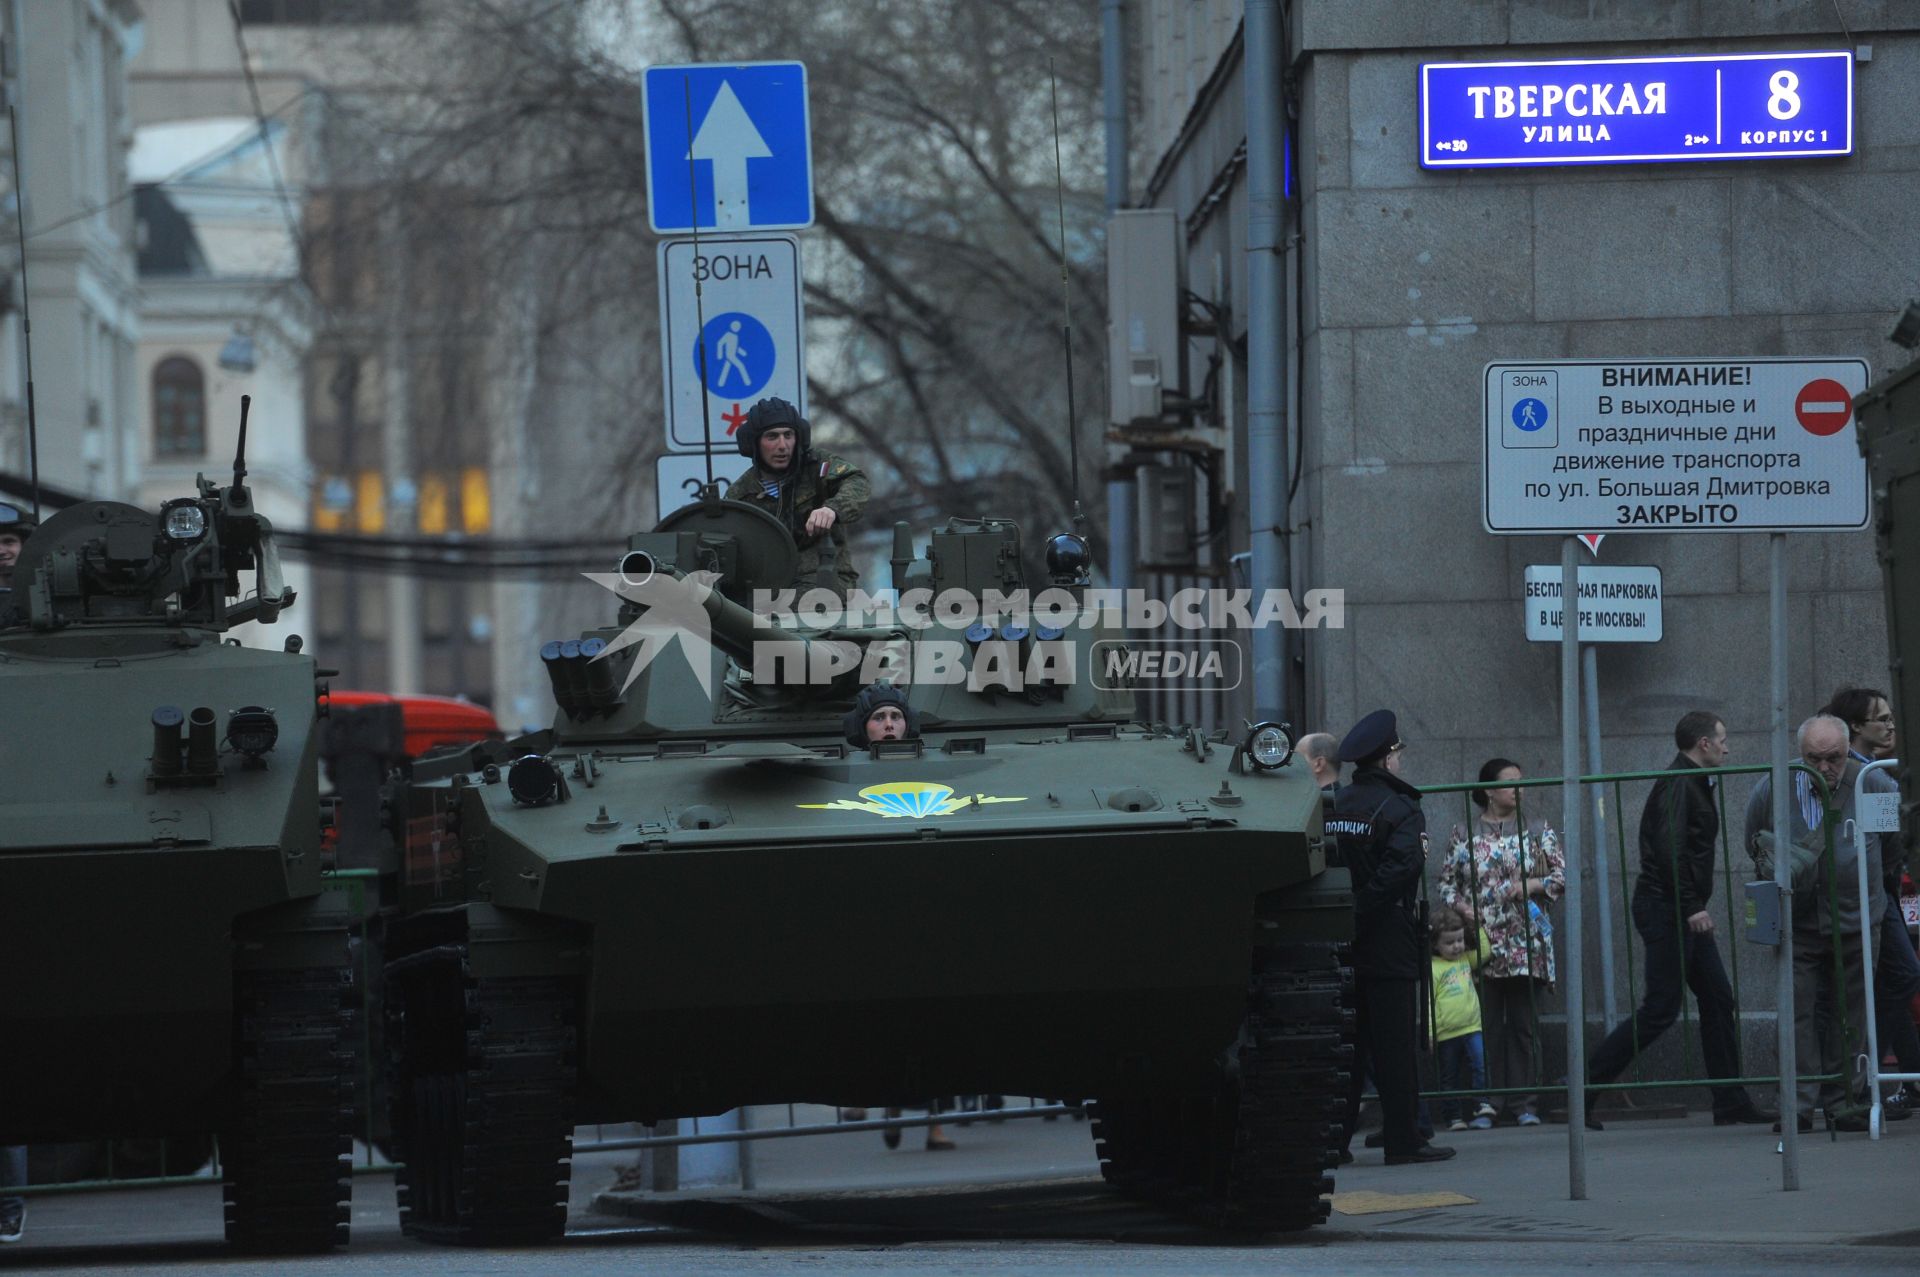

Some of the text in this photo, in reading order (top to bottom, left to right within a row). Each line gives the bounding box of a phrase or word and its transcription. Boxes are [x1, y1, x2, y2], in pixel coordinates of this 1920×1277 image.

[1467, 82, 1667, 119] ТВЕРСКАЯ
[1767, 69, 1801, 121] 8
[1522, 125, 1611, 144] УЛИЦА
[1684, 134, 1696, 146] 2
[1741, 130, 1828, 145] КОРПУС 1
[1451, 139, 1468, 152] 30
[692, 254, 772, 281] ЗОНА
[1512, 375, 1548, 387] ЗОНА
[1601, 366, 1752, 387] ВНИМАНИЕ!
[1598, 396, 1756, 417] В выходные и
[1578, 424, 1776, 446] праздничные дни
[1552, 452, 1801, 474] движение транспорта
[1524, 476, 1831, 502] по ул. Большая Дмитровка
[1616, 503, 1738, 525] ЗАКРЫТО
[1526, 582, 1659, 600] БЕСПЛНАЯ ПАРКОВКА
[1540, 610, 1646, 629] В ЦЕРЕ МОСКВЫ!
